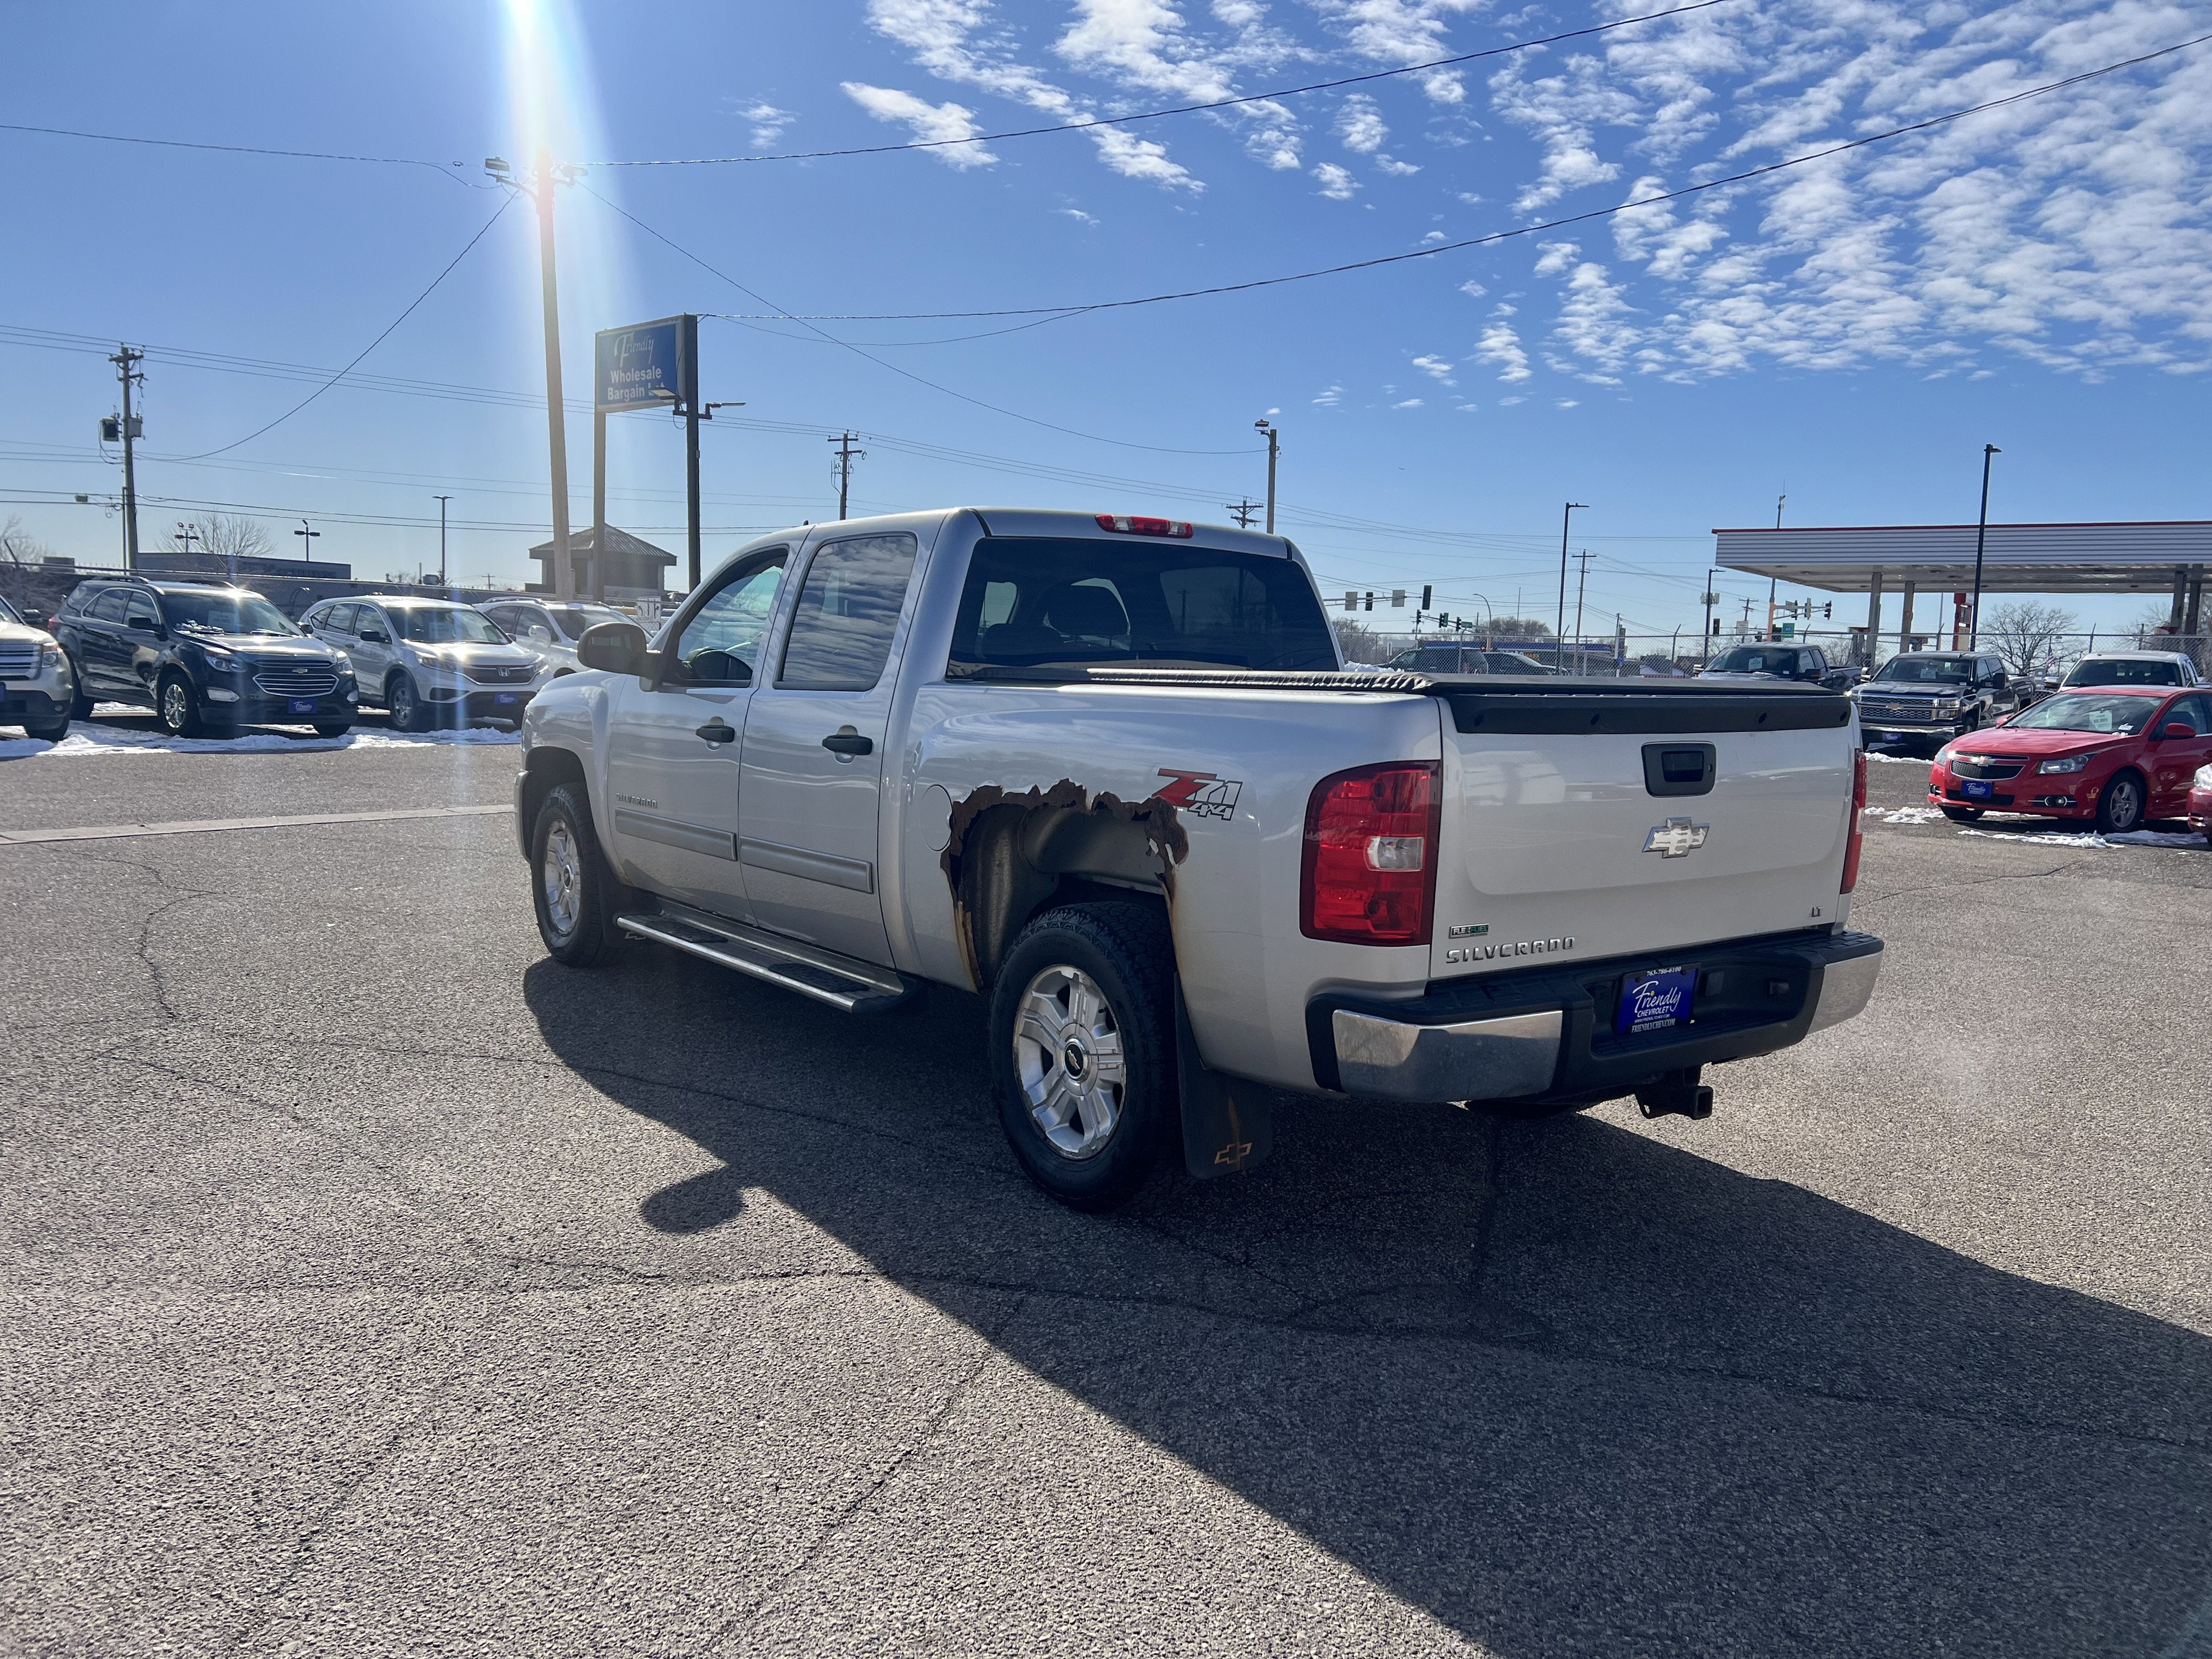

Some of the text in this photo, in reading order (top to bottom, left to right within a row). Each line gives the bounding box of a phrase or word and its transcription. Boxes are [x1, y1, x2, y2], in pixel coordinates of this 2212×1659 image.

[614, 331, 654, 368] Friendly
[610, 365, 662, 384] Wholesale
[607, 385, 645, 402] Bargain
[1446, 936, 1575, 963] SILVERADO
[1632, 980, 1681, 1013] Friendly
[1637, 1006, 1670, 1018] CHEVROLET
